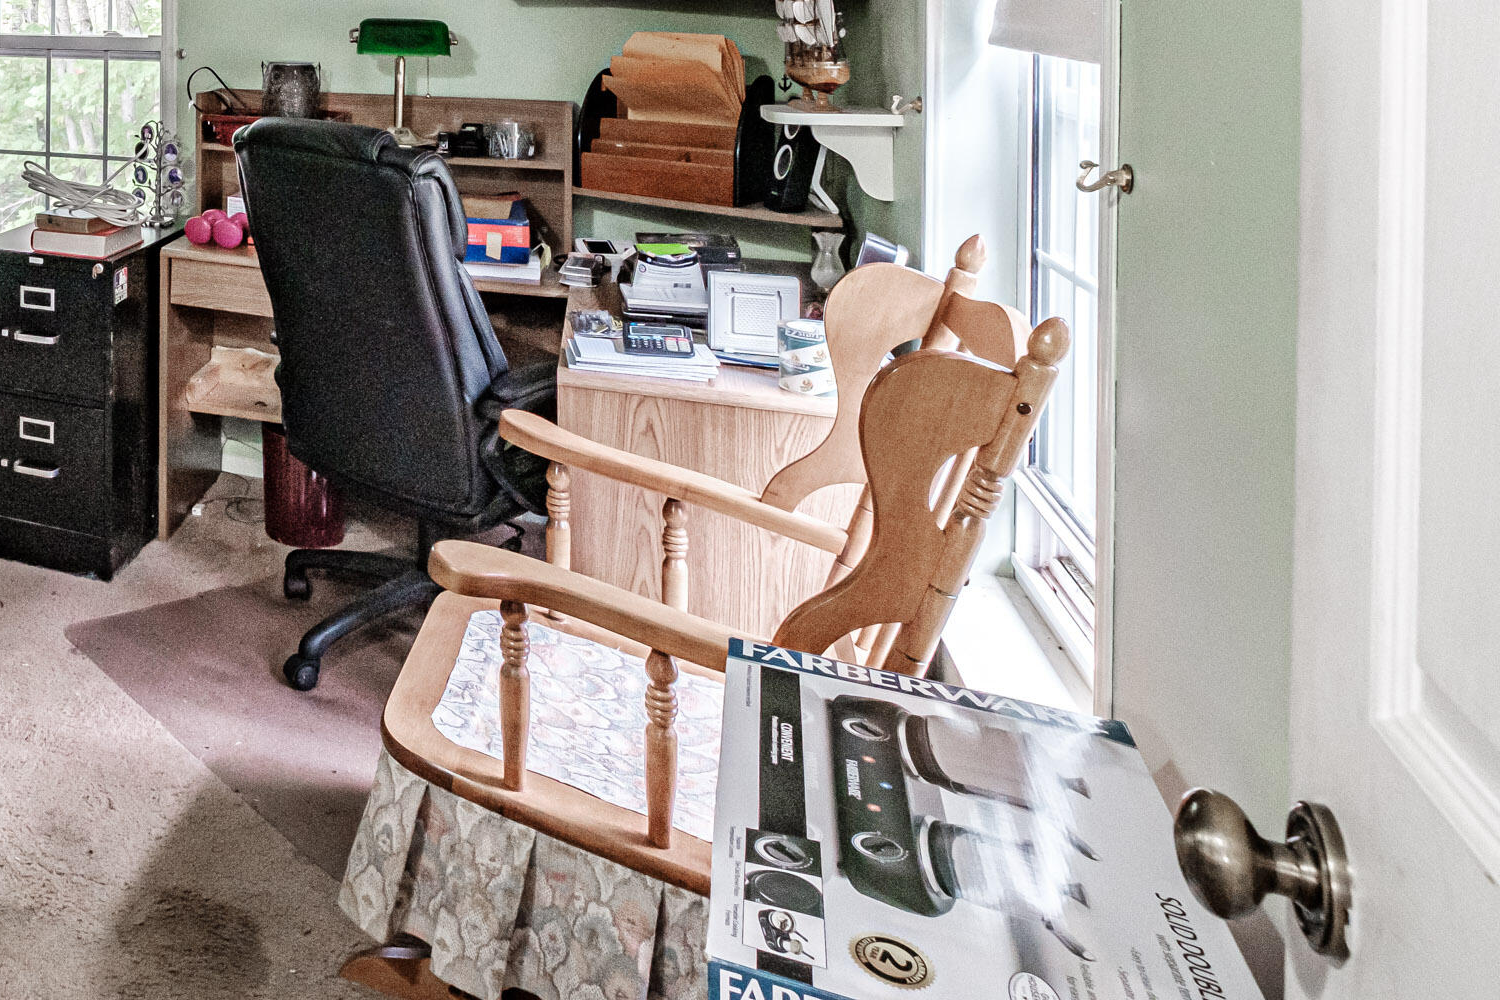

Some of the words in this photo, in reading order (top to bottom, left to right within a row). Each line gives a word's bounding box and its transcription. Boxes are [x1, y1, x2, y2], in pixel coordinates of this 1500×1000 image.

[780, 722, 794, 762] CONVENIENT
[1155, 892, 1198, 941] SOLID
[879, 949, 913, 972] 2
